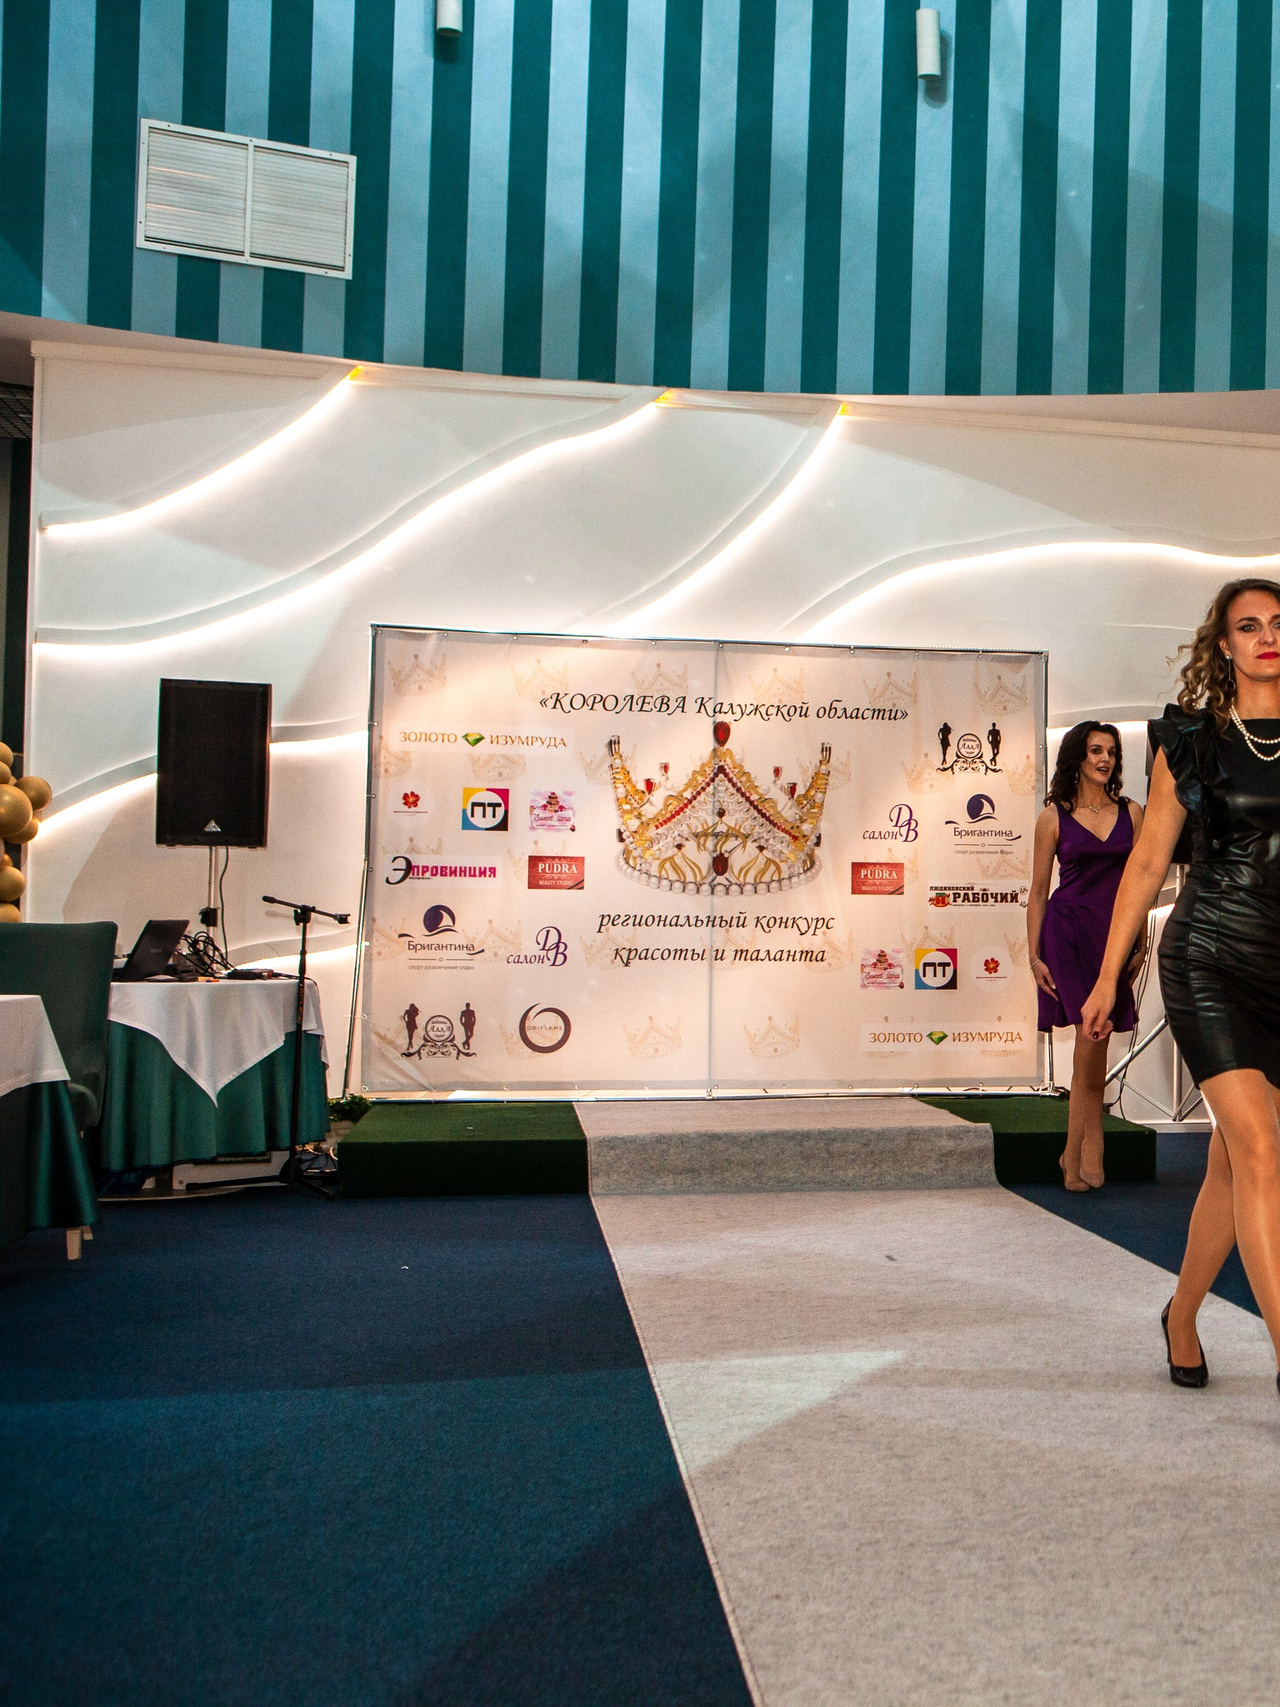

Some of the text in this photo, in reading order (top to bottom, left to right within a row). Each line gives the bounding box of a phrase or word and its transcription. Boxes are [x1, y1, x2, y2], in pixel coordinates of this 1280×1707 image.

[539, 692, 909, 723] «КОРОЛЕВА Калужской области»
[399, 731, 568, 749] ЗОЛОТО ИЗУМРУДА
[470, 801, 503, 818] ПТ
[862, 830, 898, 840] салон
[953, 826, 1014, 839] Бригантина
[538, 863, 578, 874] PUDRA
[860, 869, 898, 879] PUDRA
[952, 889, 1019, 904] РАБОЧИЙ
[596, 911, 836, 937] региональный конкурс
[407, 940, 476, 953] Бригантина
[506, 954, 546, 964] салон
[613, 946, 827, 968] красоты и таланта
[922, 961, 952, 978] ПТ
[868, 1031, 1024, 1044] ЗОЛОТО ИЗУМРУДА
